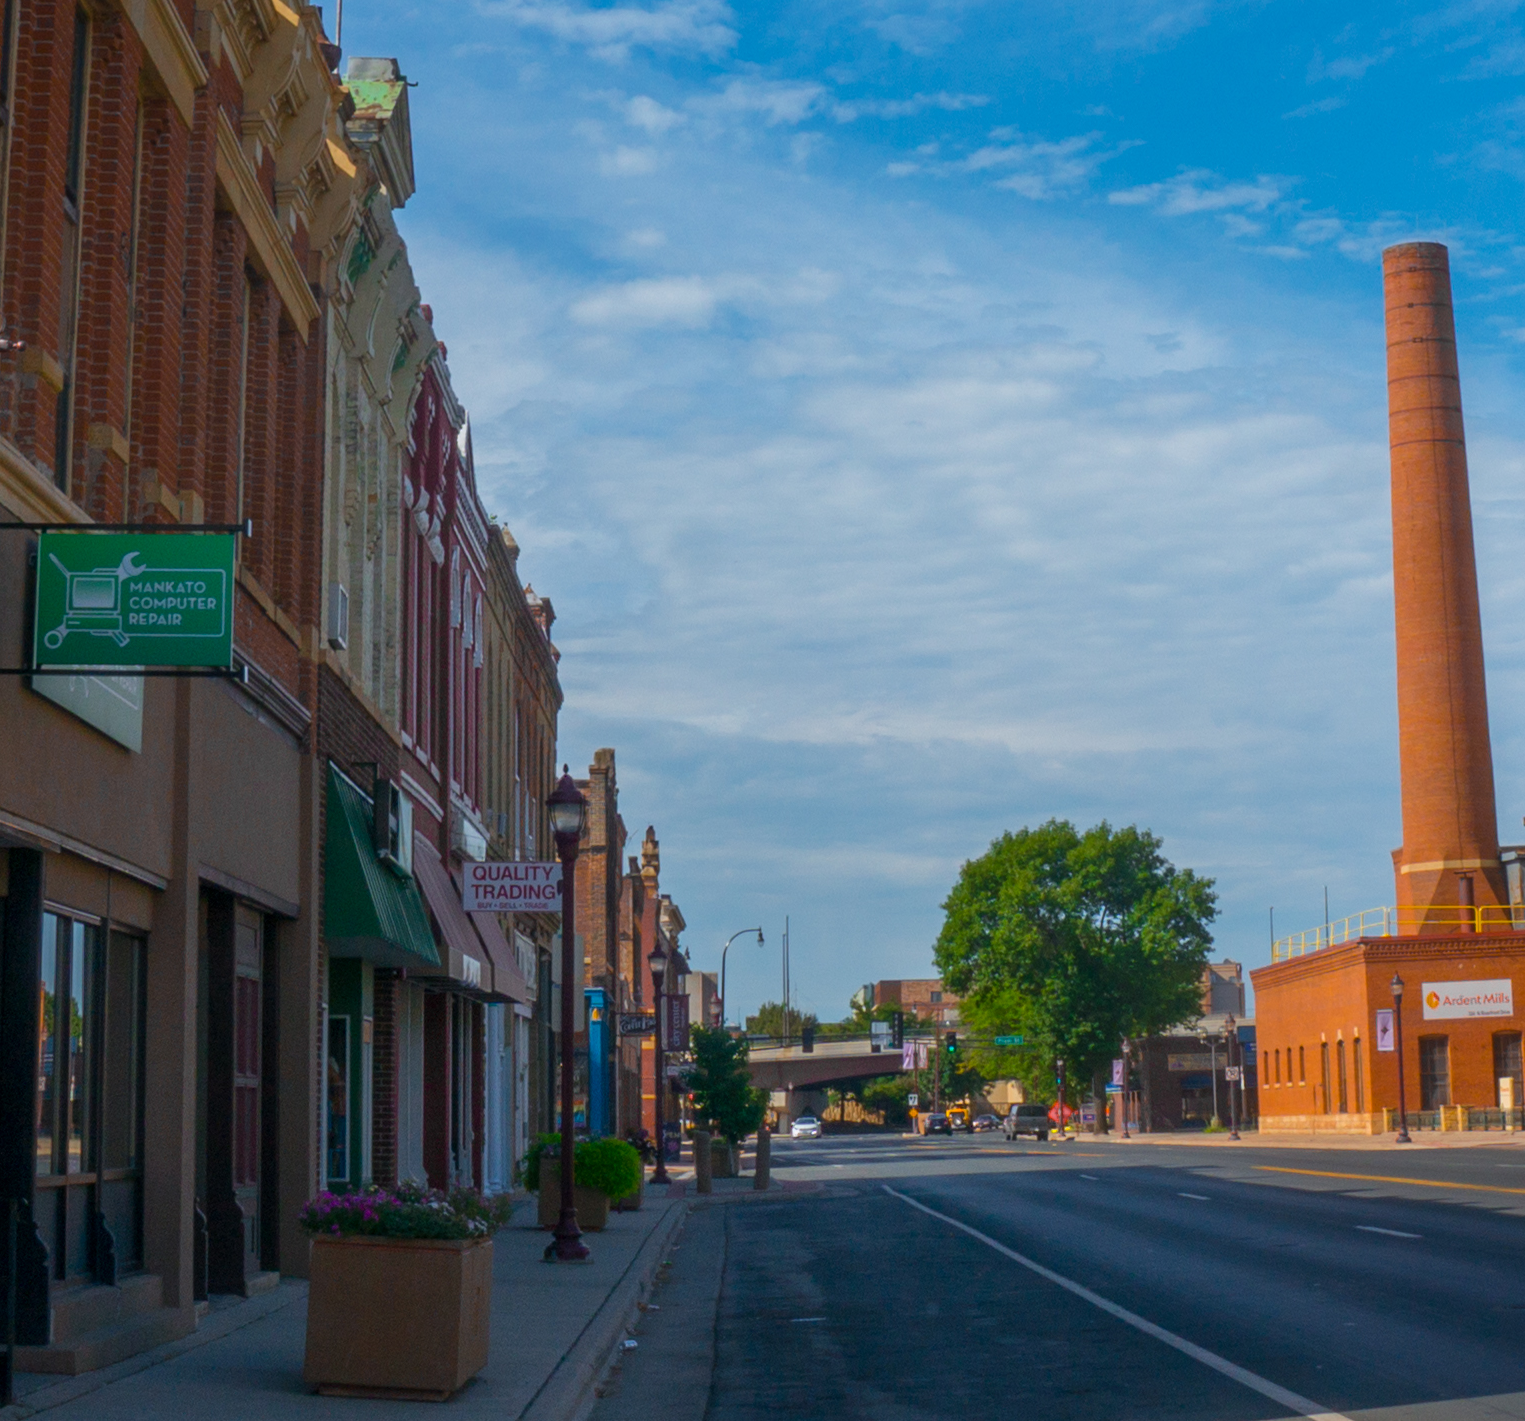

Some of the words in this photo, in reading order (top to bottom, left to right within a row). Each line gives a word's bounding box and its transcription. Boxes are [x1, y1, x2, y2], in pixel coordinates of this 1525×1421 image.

[129, 581, 206, 593] MANKATO
[129, 597, 217, 610] COMPUTER
[129, 613, 182, 625] REPAIR
[473, 866, 554, 881] QUALITY
[471, 884, 555, 899] TRADING
[1443, 995, 1481, 1006] Ardent
[1483, 993, 1510, 1004] Mills
